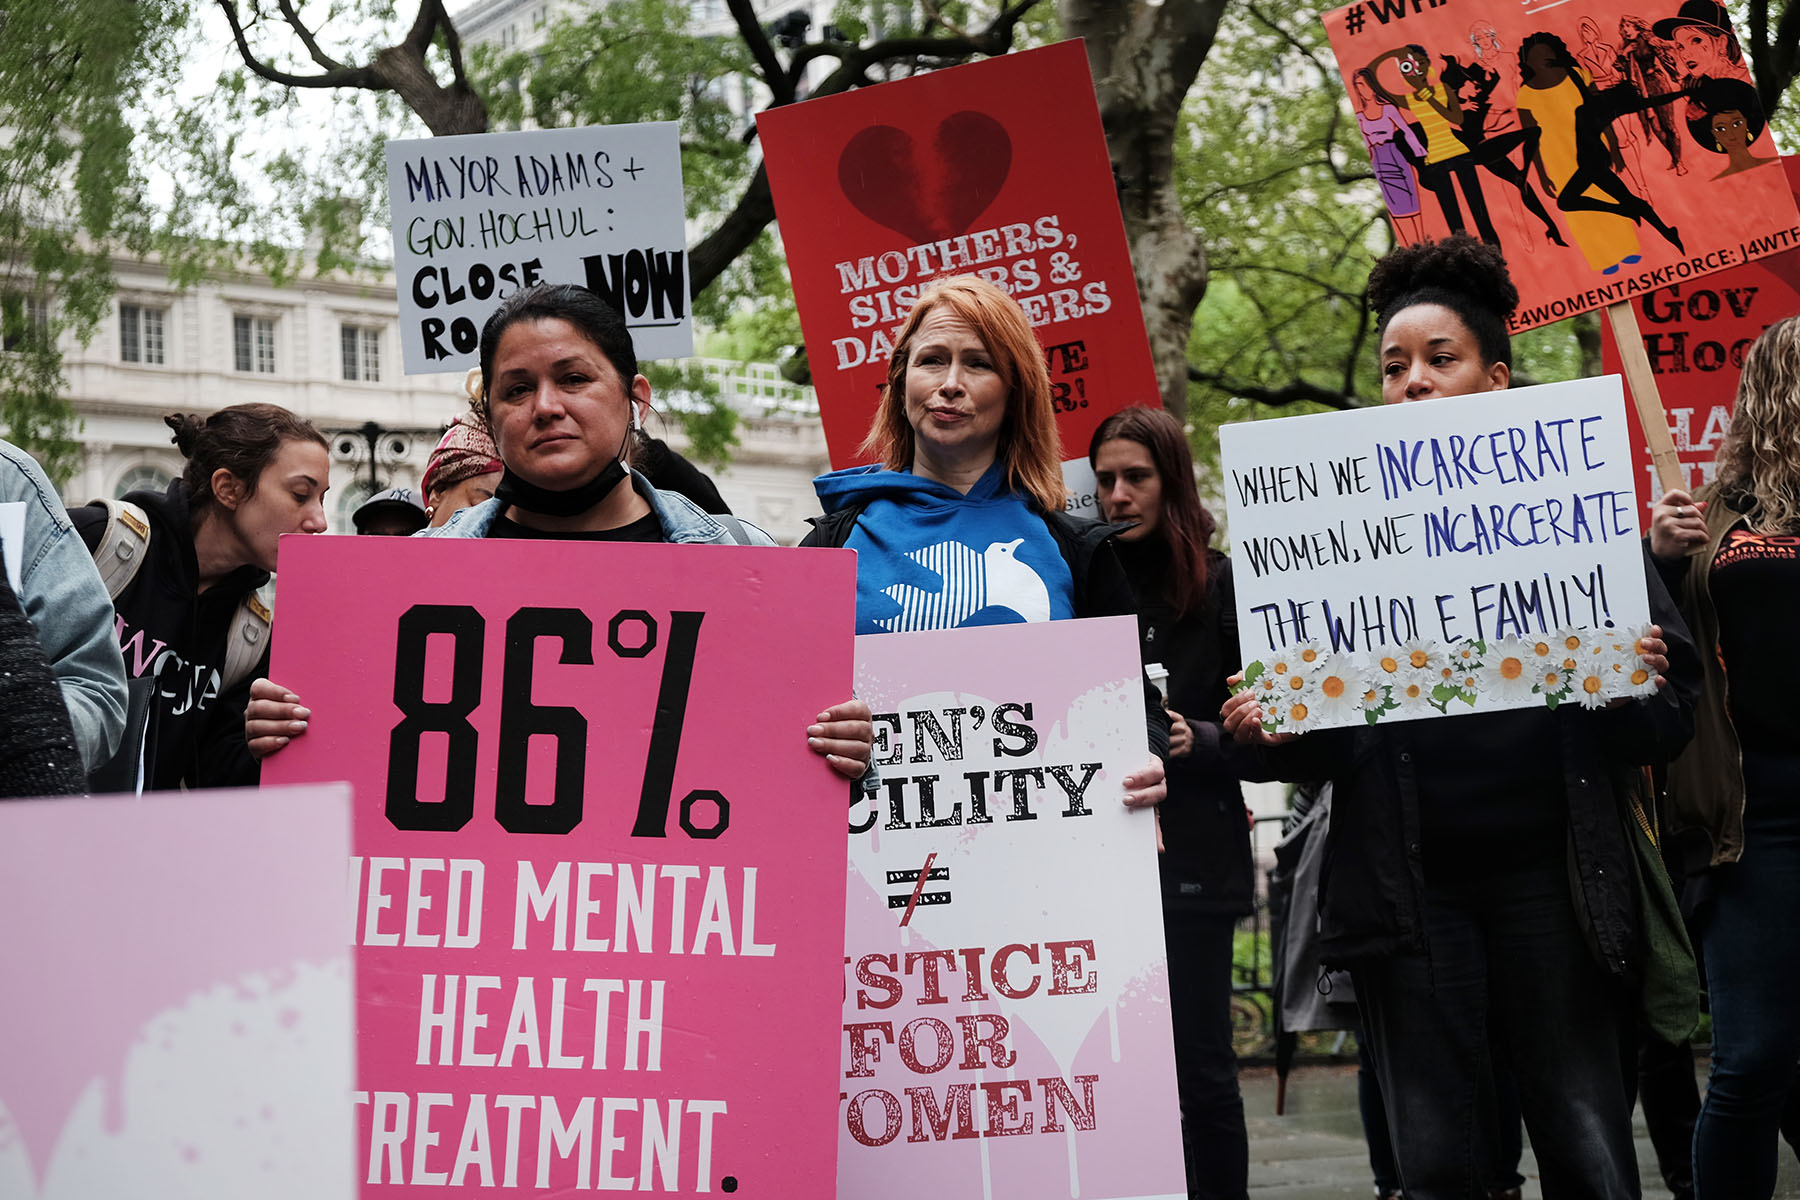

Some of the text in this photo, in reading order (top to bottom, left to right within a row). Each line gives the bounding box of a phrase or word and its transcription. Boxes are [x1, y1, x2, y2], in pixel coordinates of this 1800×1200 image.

[405, 155, 511, 203] MAYOR
[514, 151, 614, 199] ADAMS
[412, 247, 686, 320] CLOSE NOW
[835, 215, 1078, 295] MOTHERS,
[848, 251, 1082, 329] SISRS &
[1232, 463, 1318, 507] WHEN
[1329, 456, 1371, 496] WE
[1376, 416, 1605, 501] INCARCERATE
[1243, 490, 1633, 578] WOMEN, WE INCARCERATE
[1250, 598, 1317, 651] THE
[385, 604, 730, 839] 86%
[512, 860, 776, 957] MENTAL
[843, 939, 1098, 1009] STICE
[416, 974, 665, 1071] HEALTH
[843, 1014, 1017, 1078] FOR
[840, 1074, 1099, 1147] OMEN
